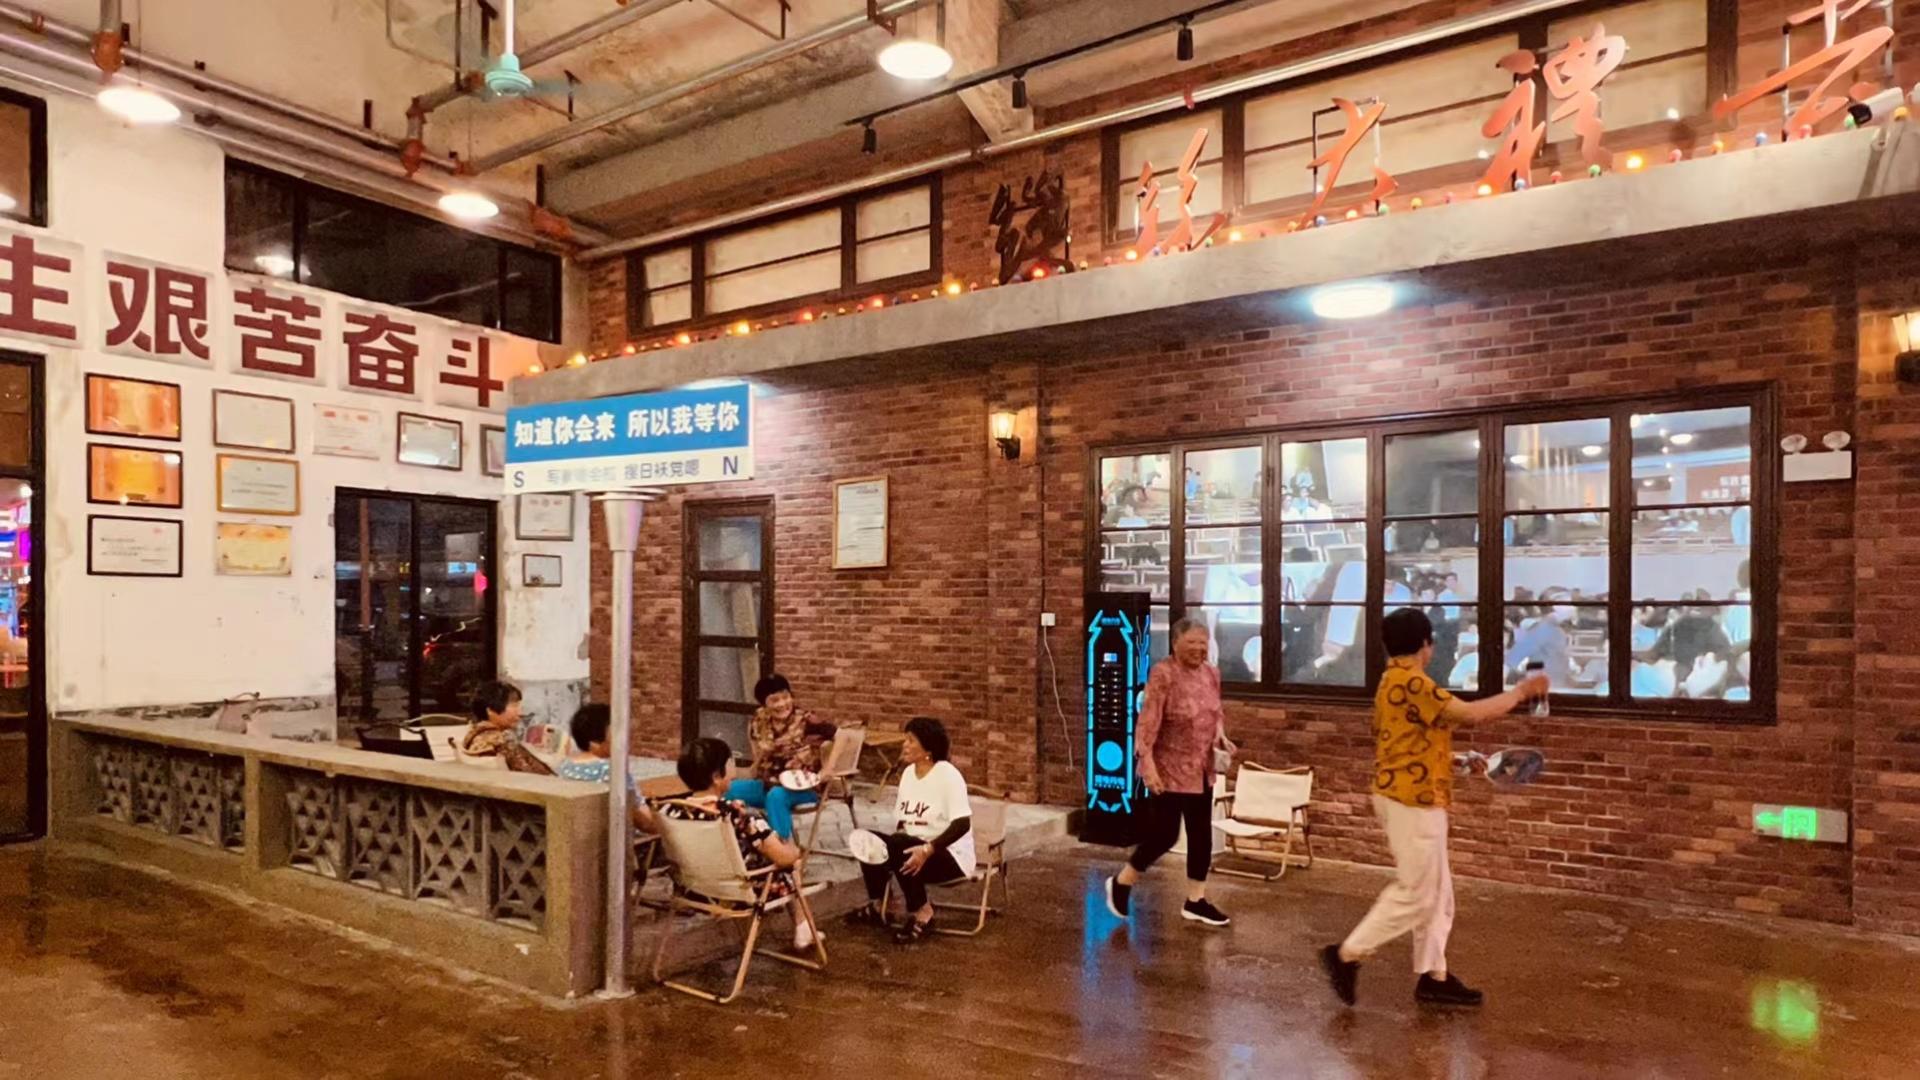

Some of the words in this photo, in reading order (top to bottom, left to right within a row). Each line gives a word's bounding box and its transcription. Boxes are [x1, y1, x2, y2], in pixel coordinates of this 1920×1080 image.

[514, 411, 616, 447] 知道你会来
[627, 401, 740, 438] 所以我等你
[722, 455, 738, 475] N
[513, 471, 525, 488] S
